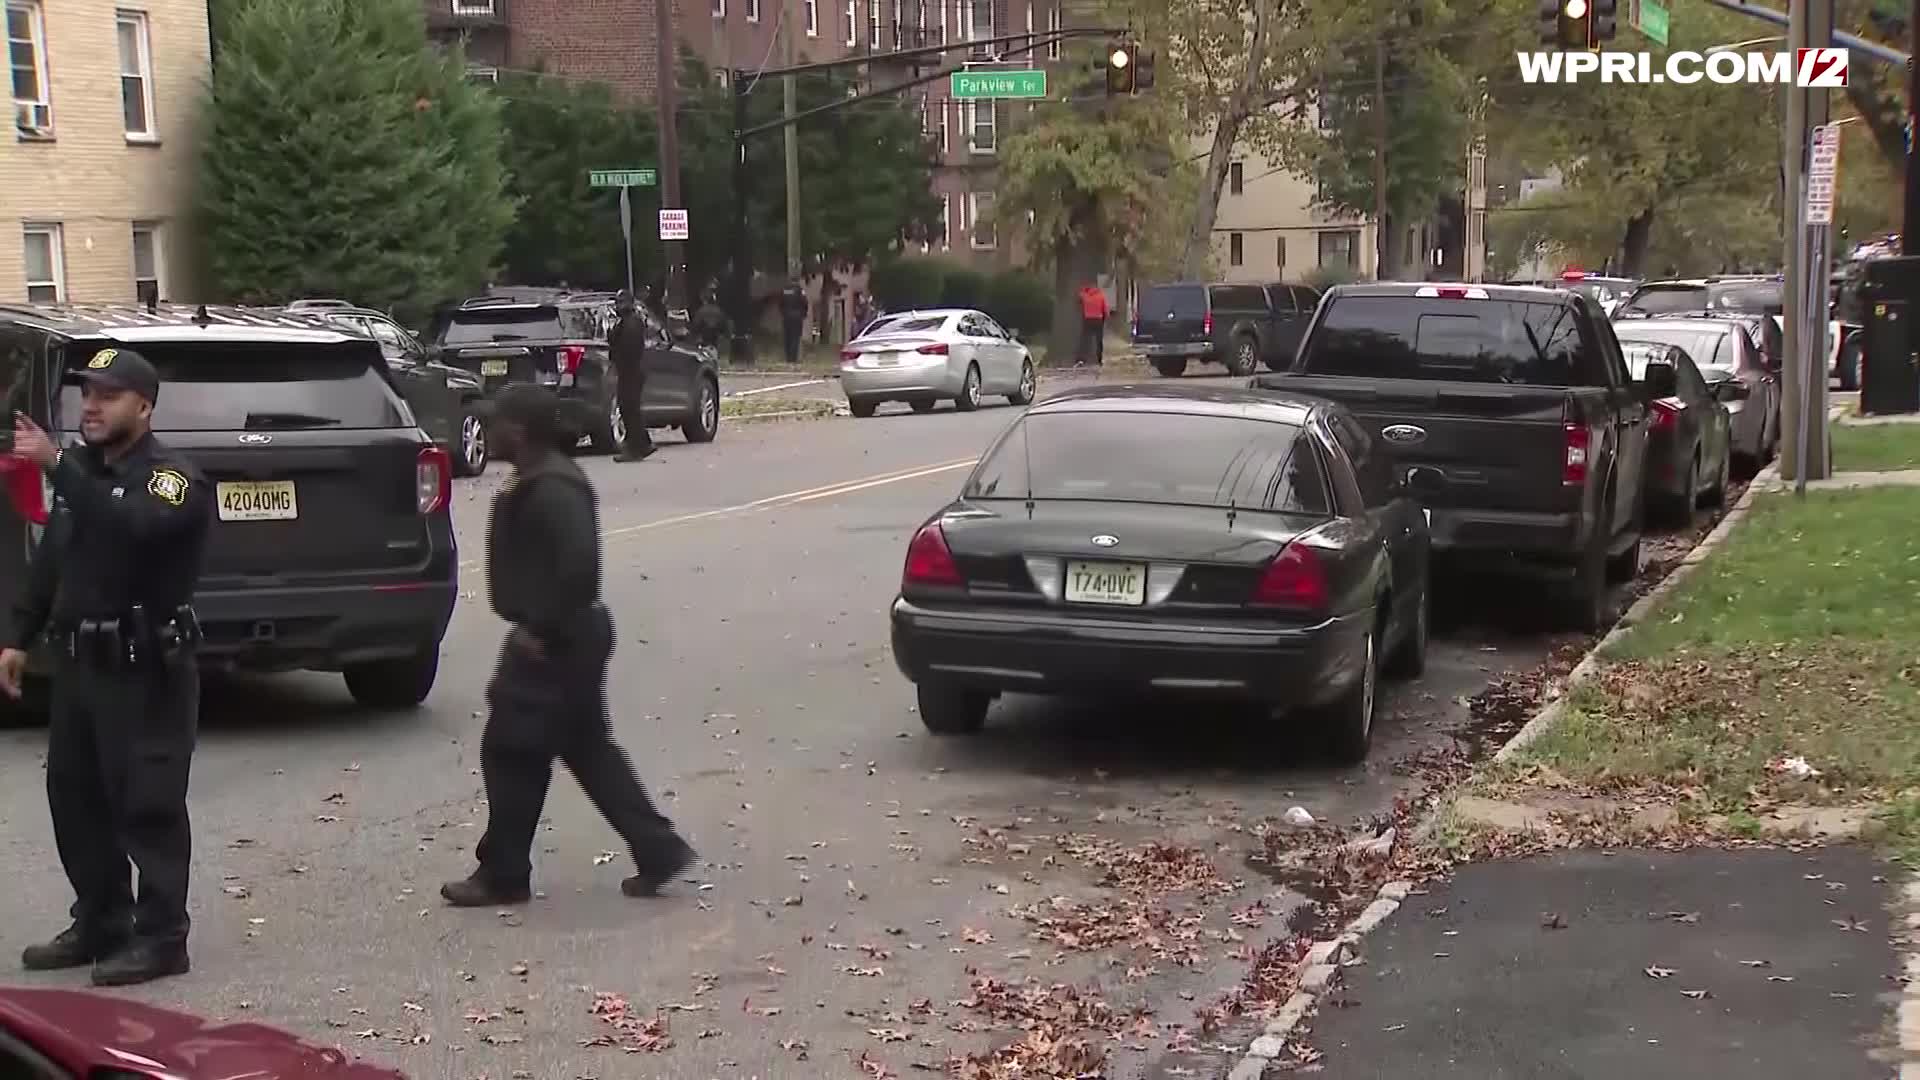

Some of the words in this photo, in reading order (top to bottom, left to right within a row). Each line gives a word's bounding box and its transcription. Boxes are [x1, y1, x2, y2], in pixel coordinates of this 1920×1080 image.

[960, 77, 1015, 93] Parkview
[661, 222, 687, 231] PARKING
[223, 490, 290, 511] 42040MG
